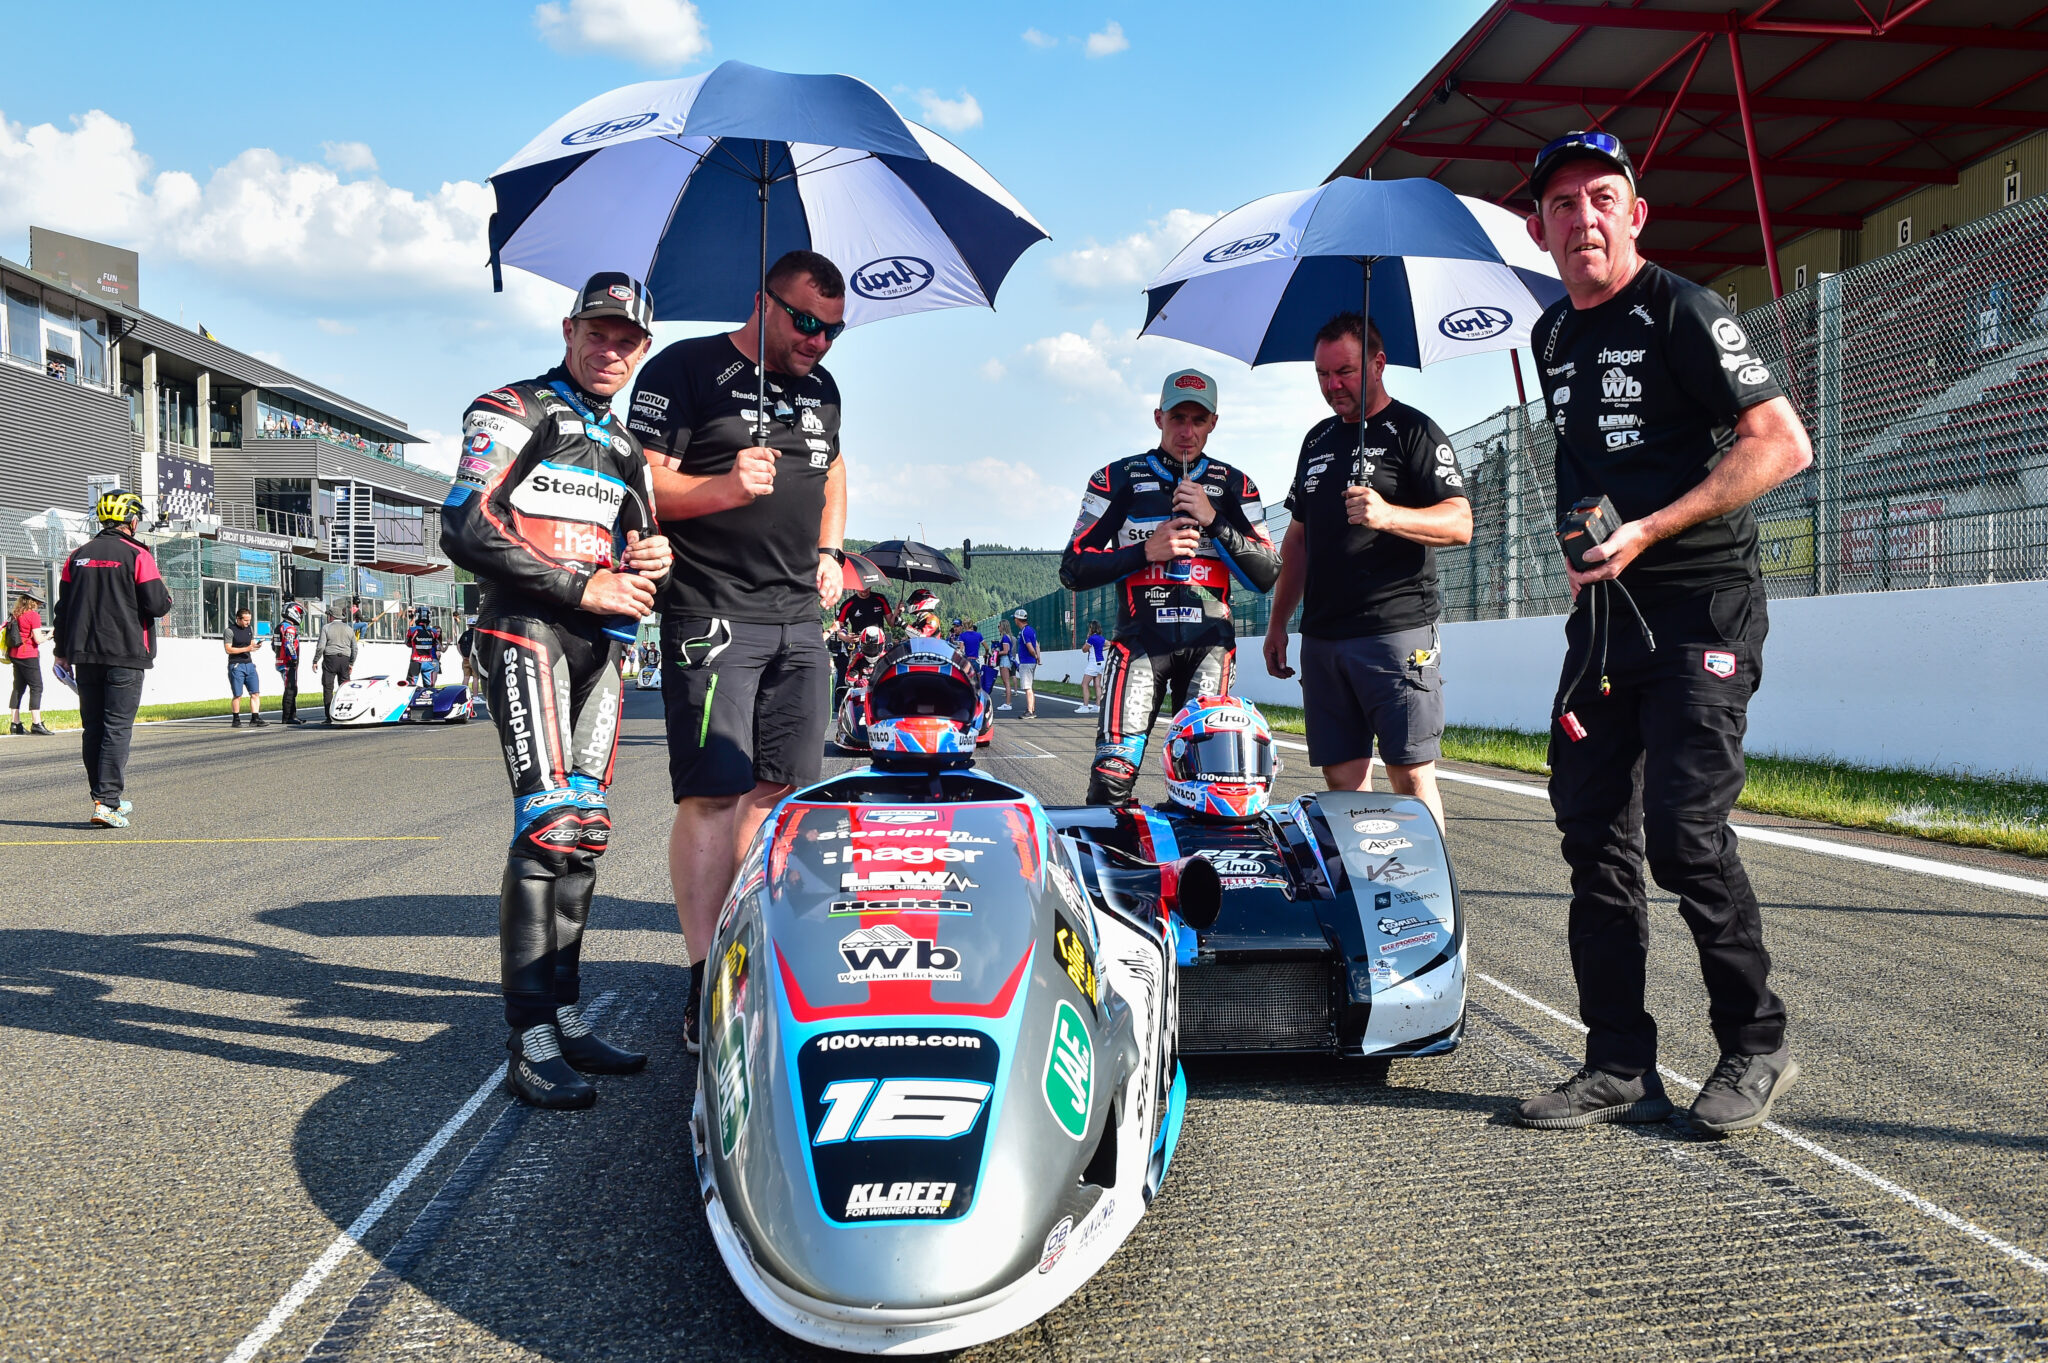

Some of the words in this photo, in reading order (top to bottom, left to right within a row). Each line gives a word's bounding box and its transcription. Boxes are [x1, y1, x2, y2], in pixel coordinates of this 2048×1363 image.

[569, 114, 653, 138] Arai
[2007, 177, 2017, 201] H
[1900, 221, 1908, 242] G
[1209, 233, 1275, 256] Arai
[103, 272, 117, 282] FUN
[1797, 268, 1804, 288] D
[102, 285, 118, 294] RIDES
[1598, 347, 1646, 366] :hager
[717, 361, 744, 385] Haith
[639, 393, 667, 407] MOTUL
[732, 390, 769, 402] Steadpn
[469, 419, 504, 431] Kevlar
[1598, 414, 1635, 425] LEW
[628, 423, 661, 436] HONDA
[1606, 430, 1640, 448] GR
[532, 475, 624, 506] Steadpla
[1145, 562, 1212, 580] :her
[1145, 590, 1170, 599] Pillar
[1158, 608, 1192, 617] LEW
[335, 702, 353, 712] 44
[503, 647, 532, 772] Steadplan
[1213, 712, 1245, 723] Arai
[581, 687, 617, 771] :hager
[1196, 773, 1267, 783] 100vans.com
[577, 791, 605, 803] RS
[581, 829, 609, 841] RS
[817, 828, 971, 842] Steadplan
[1368, 839, 1407, 850] Apex
[823, 846, 984, 864] :hager
[1192, 850, 1277, 860] RST
[1217, 860, 1258, 873] Arai
[840, 871, 952, 887] LEW
[1394, 890, 1418, 900] DFDS
[1399, 893, 1439, 904] SEAWAYS
[830, 897, 972, 913] Haith
[1385, 917, 1418, 929] COMPLETE
[840, 972, 898, 982] Wyckham
[902, 971, 961, 980] Blackwell
[816, 1034, 981, 1051] 100vans.com
[1054, 1018, 1091, 1115] JAE
[518, 1060, 557, 1091] daytona
[812, 1078, 994, 1146] 16
[846, 1208, 867, 1217] FOR
[869, 1206, 916, 1216] WINNERS
[918, 1206, 947, 1215] ONLY
